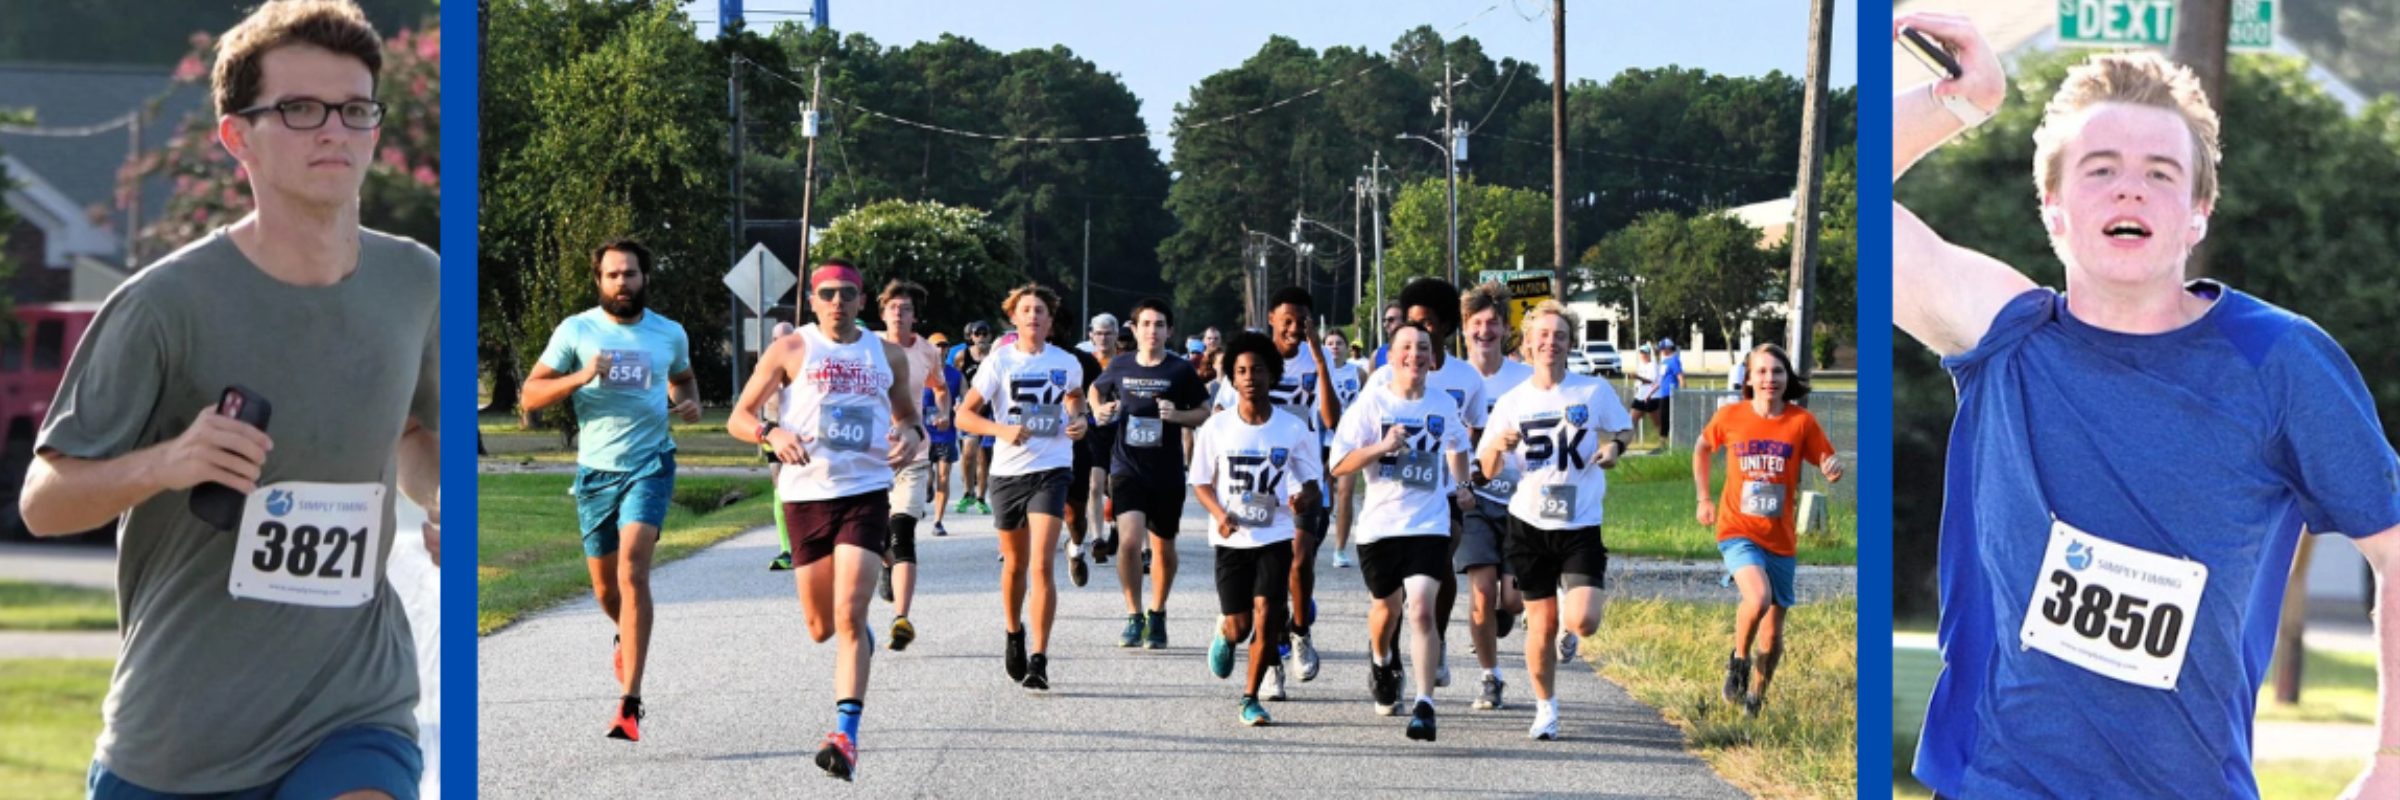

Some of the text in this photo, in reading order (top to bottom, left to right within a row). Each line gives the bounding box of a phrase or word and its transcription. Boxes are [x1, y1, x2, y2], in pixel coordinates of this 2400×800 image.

[609, 366, 643, 381] 654
[828, 423, 864, 442] 640
[1026, 417, 1054, 431] 617
[1130, 429, 1156, 443] 615
[1519, 418, 1587, 471] 5K
[1739, 454, 1785, 473] UNITED
[1402, 465, 1433, 482] 616
[299, 501, 368, 512] SIMPLY TIMING
[1748, 496, 1778, 512] 618
[252, 520, 368, 579] 3821
[2098, 558, 2182, 589] SIMPLY TIMING
[2042, 569, 2183, 659] 3850
